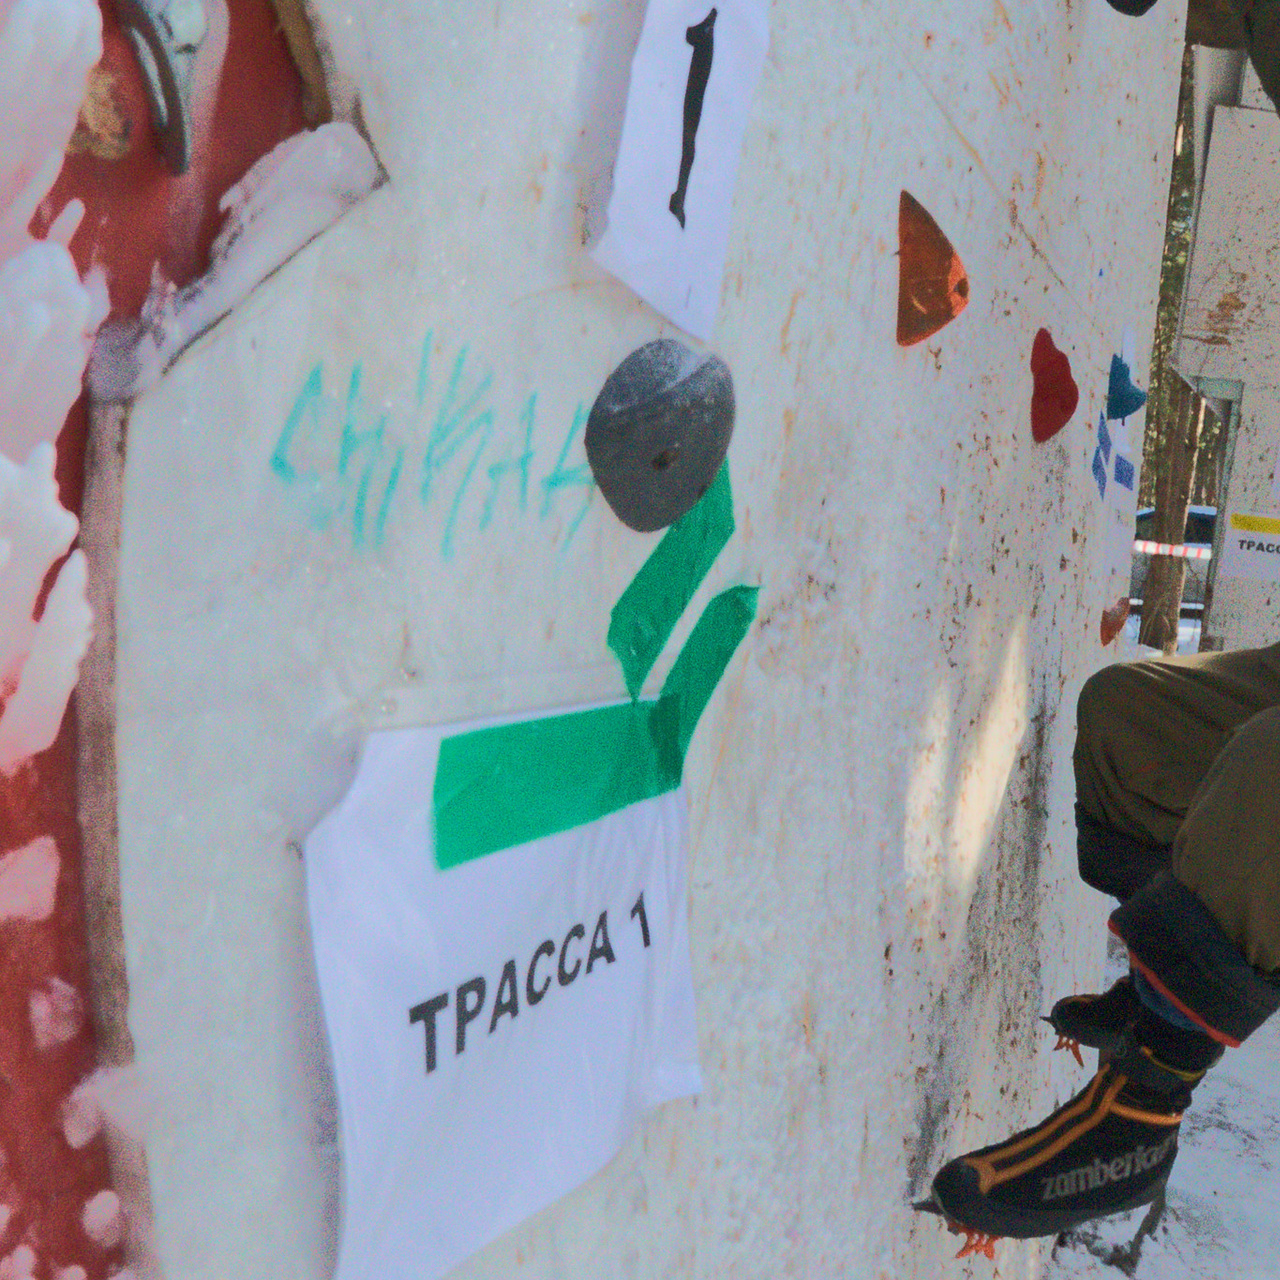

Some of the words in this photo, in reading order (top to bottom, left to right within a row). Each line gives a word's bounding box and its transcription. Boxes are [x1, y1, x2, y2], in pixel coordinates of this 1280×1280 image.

[669, 7, 717, 230] 1
[409, 910, 616, 1074] ТРАССА
[630, 891, 651, 948] 1
